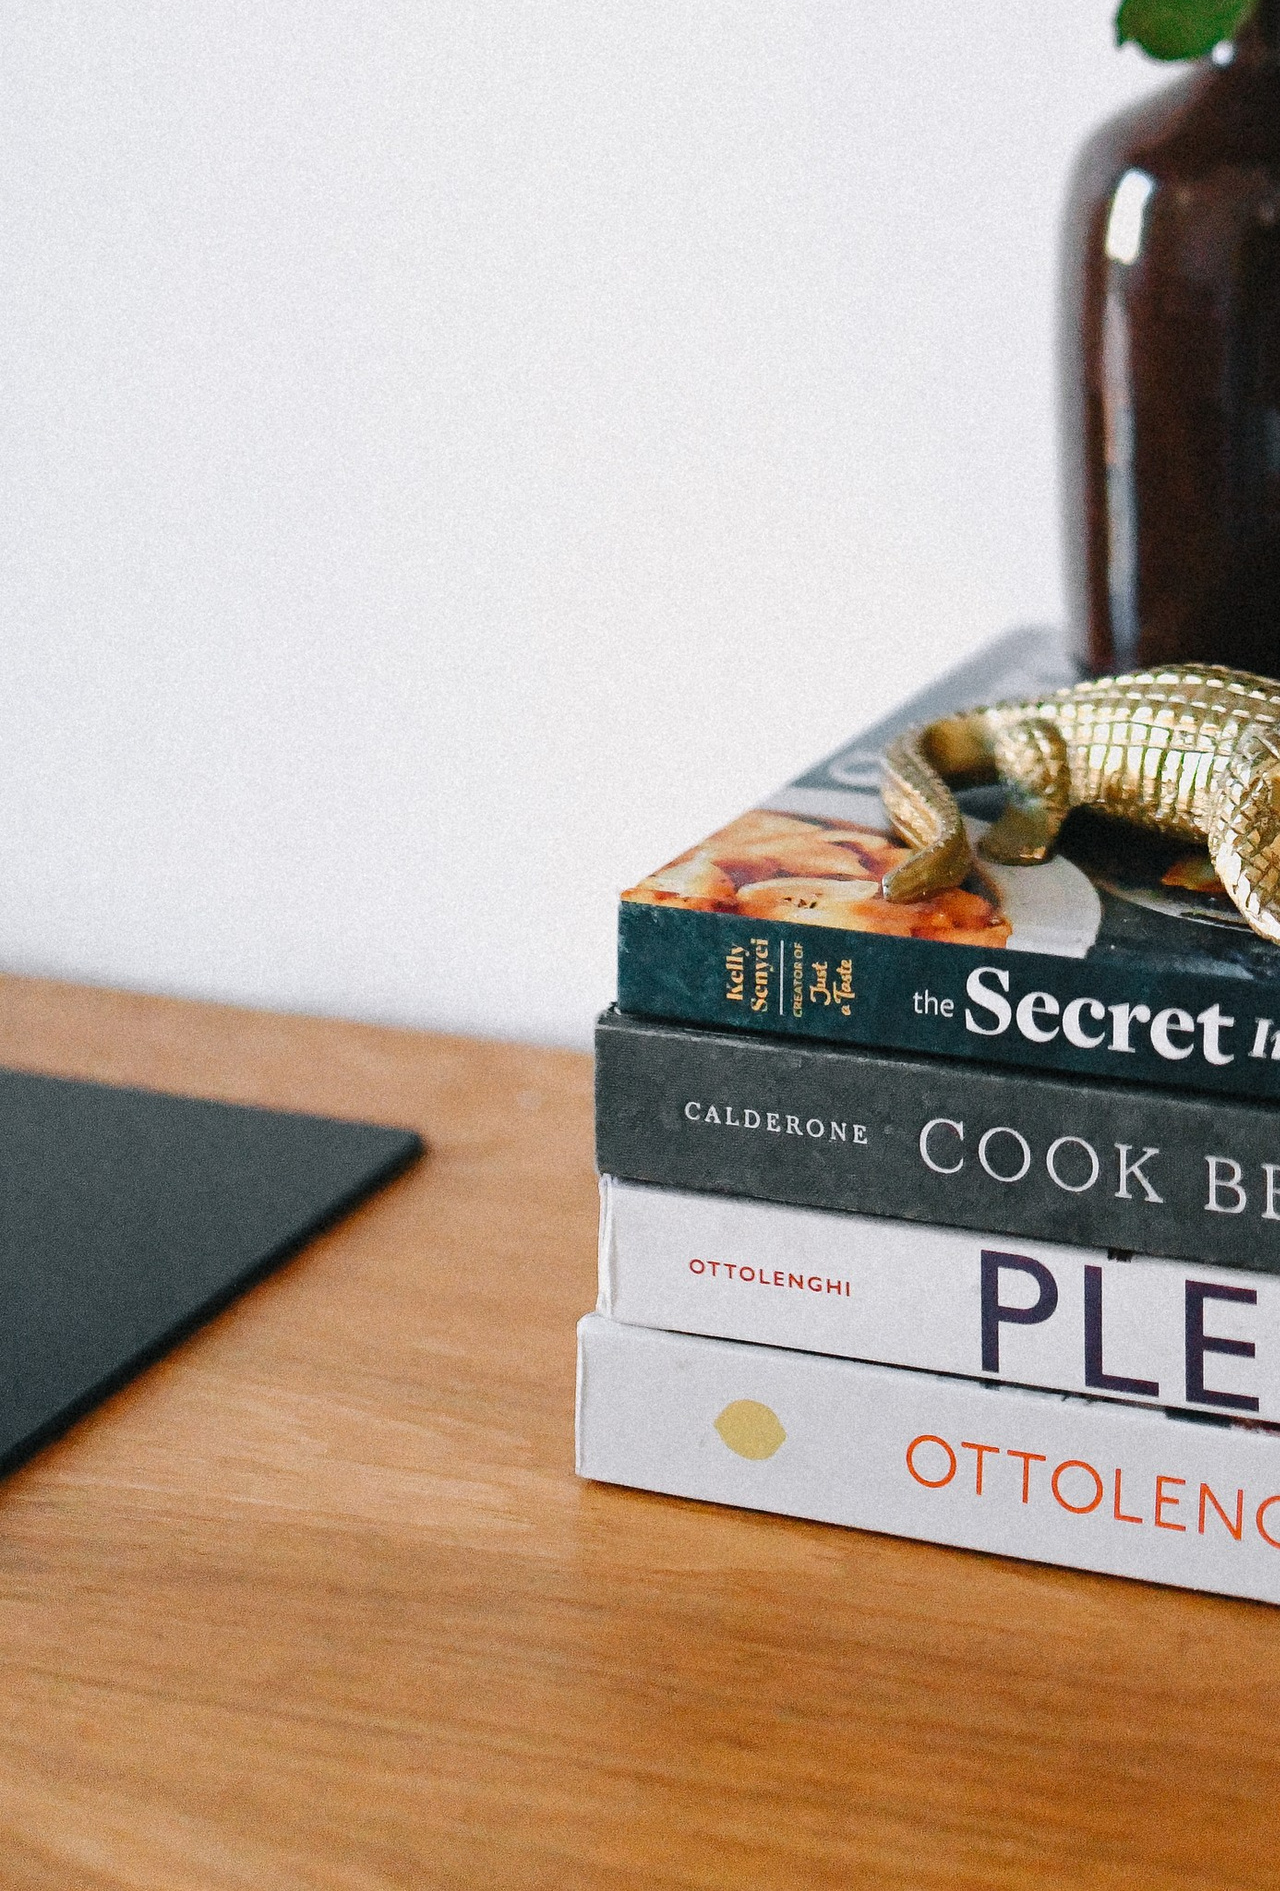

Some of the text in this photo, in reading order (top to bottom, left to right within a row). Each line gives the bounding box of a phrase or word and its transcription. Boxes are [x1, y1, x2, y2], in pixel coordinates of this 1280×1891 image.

[726, 943, 750, 1001] Kelly
[751, 938, 774, 1013] Senyei
[793, 942, 804, 1018] CREATOR OF
[810, 961, 831, 1006] Just
[832, 959, 856, 1016] a Taste
[912, 989, 955, 1017] the
[965, 966, 1235, 1065] Secret
[684, 1101, 868, 1145] CALDERONE
[918, 1117, 1163, 1205] COOK
[689, 1258, 851, 1298] OTTOLENGHI
